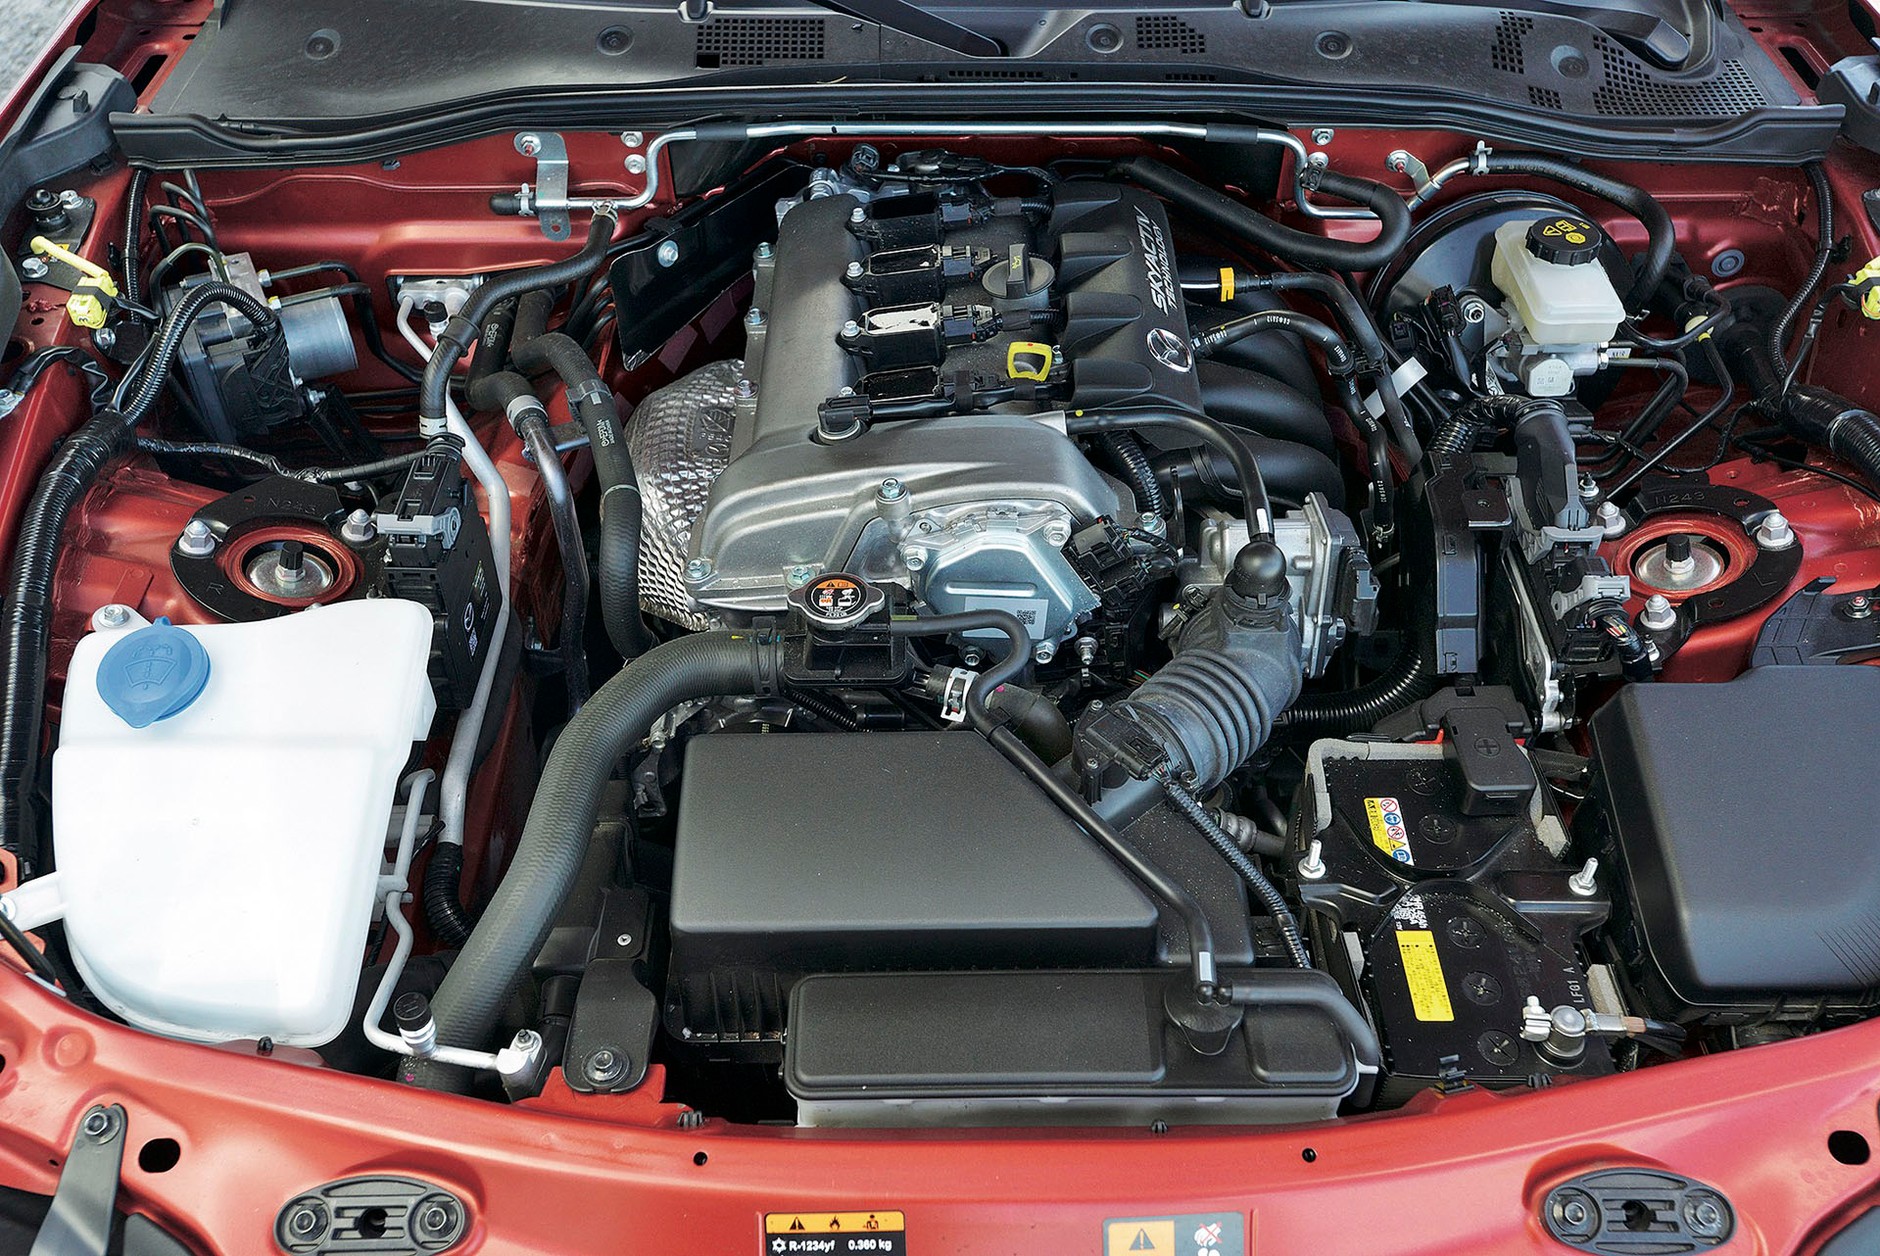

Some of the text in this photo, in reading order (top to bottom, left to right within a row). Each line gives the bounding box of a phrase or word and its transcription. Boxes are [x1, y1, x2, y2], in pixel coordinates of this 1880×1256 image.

[1134, 205, 1169, 317] SKYACTIV
[1151, 220, 1178, 310] TECHNOLOGY
[788, 1239, 836, 1254] R-1234yf
[878, 1238, 893, 1252] kg
